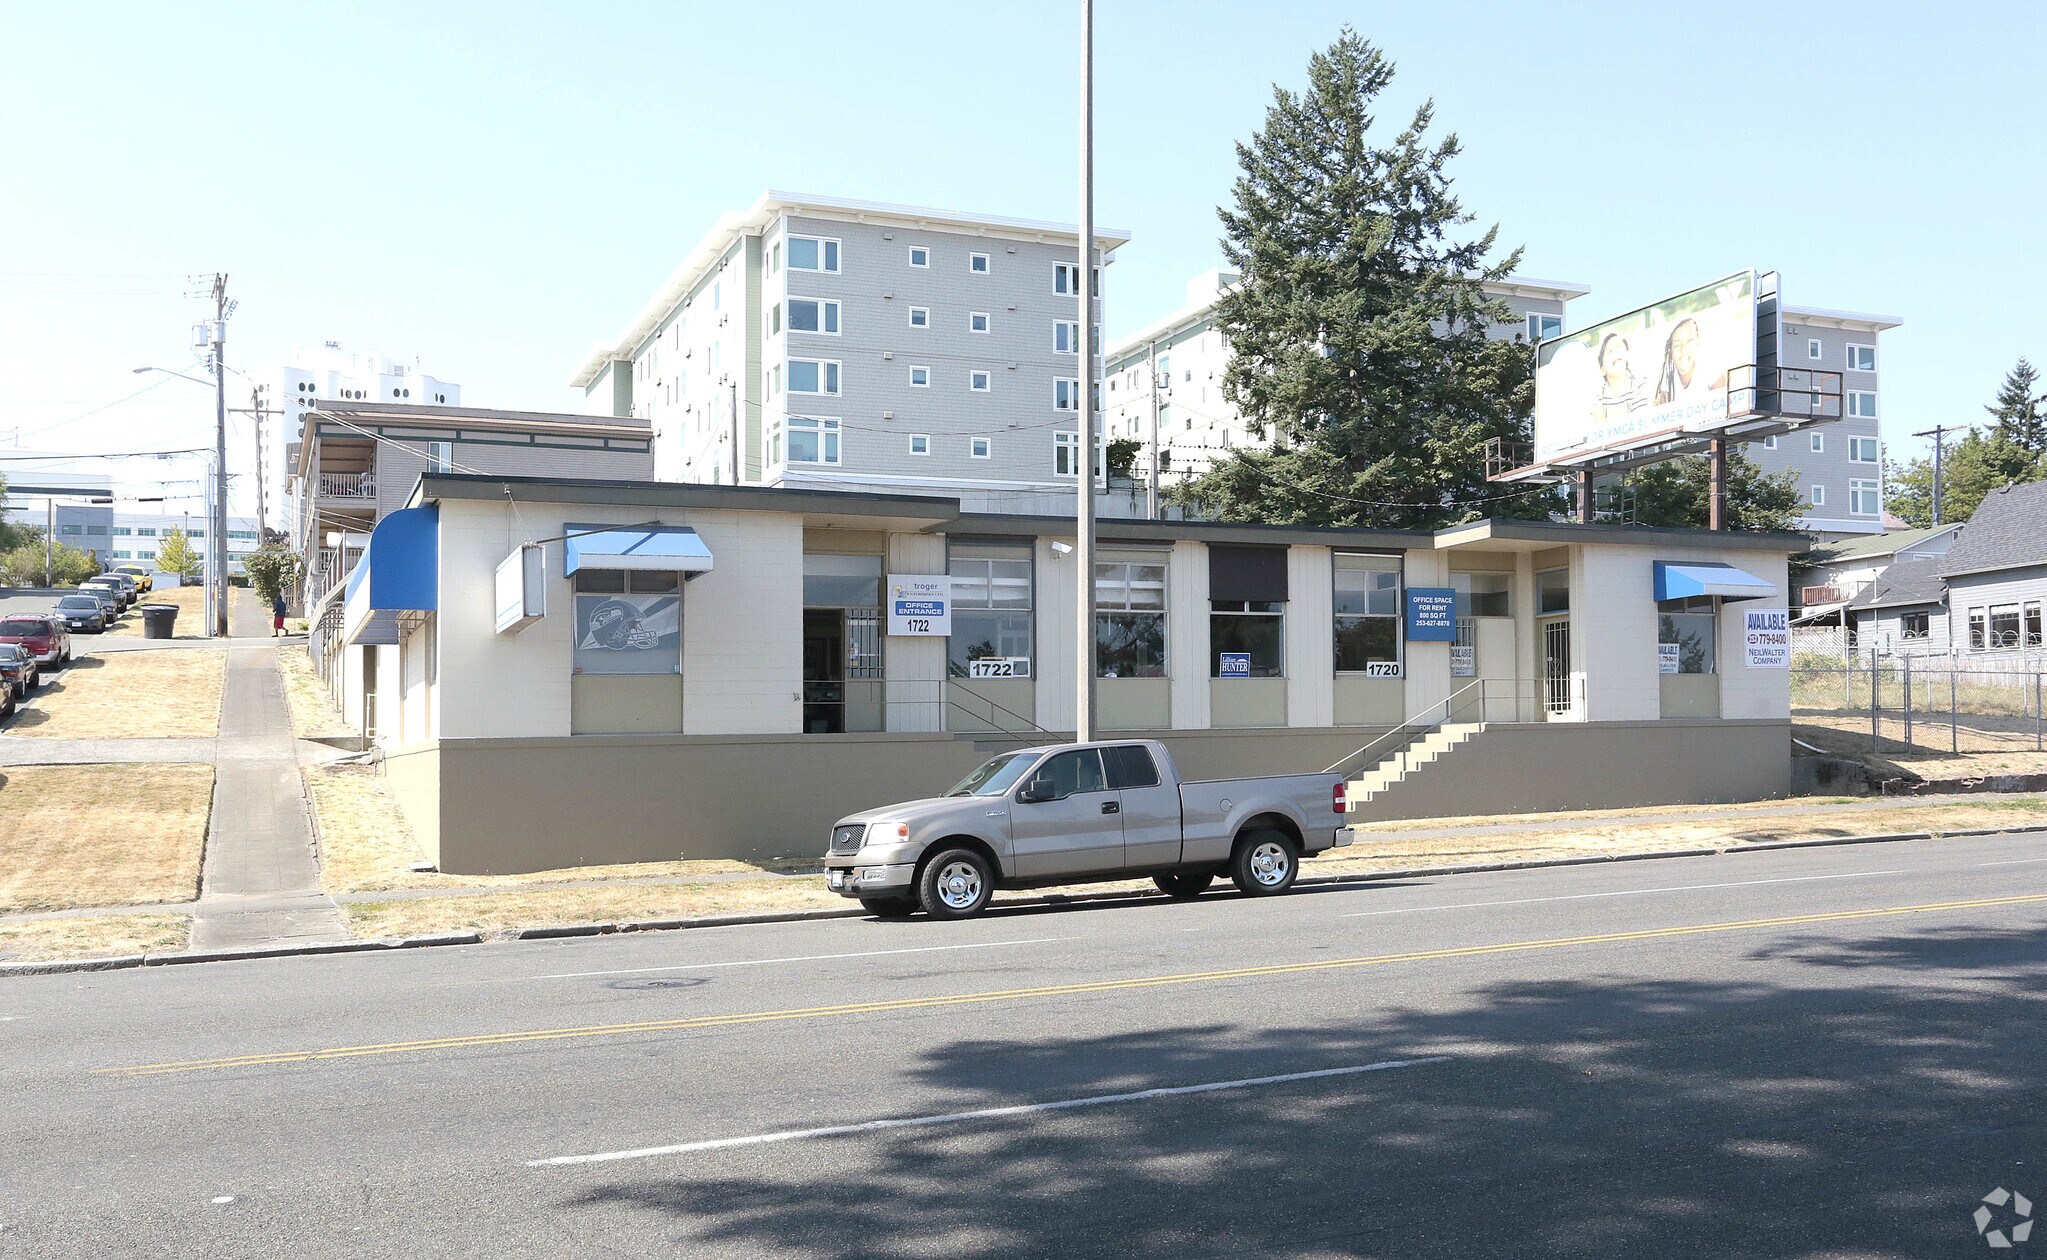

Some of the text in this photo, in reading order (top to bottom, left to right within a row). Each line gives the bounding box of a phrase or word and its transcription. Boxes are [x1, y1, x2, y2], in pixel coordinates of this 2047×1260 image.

[1607, 422, 1635, 438] YMCA
[1638, 408, 1683, 430] SUMMER
[1687, 403, 1708, 418] DAY
[1711, 392, 1745, 411] CAMP
[914, 583, 938, 591] troger
[907, 619, 929, 632] 1722
[1748, 613, 1786, 630] AVAILABLE
[1759, 633, 1787, 645] 779-8400
[1752, 656, 1782, 665] COMPANY
[972, 663, 1012, 677] 1722
[1222, 662, 1248, 672] HUNTER
[1368, 664, 1399, 676] 1720
